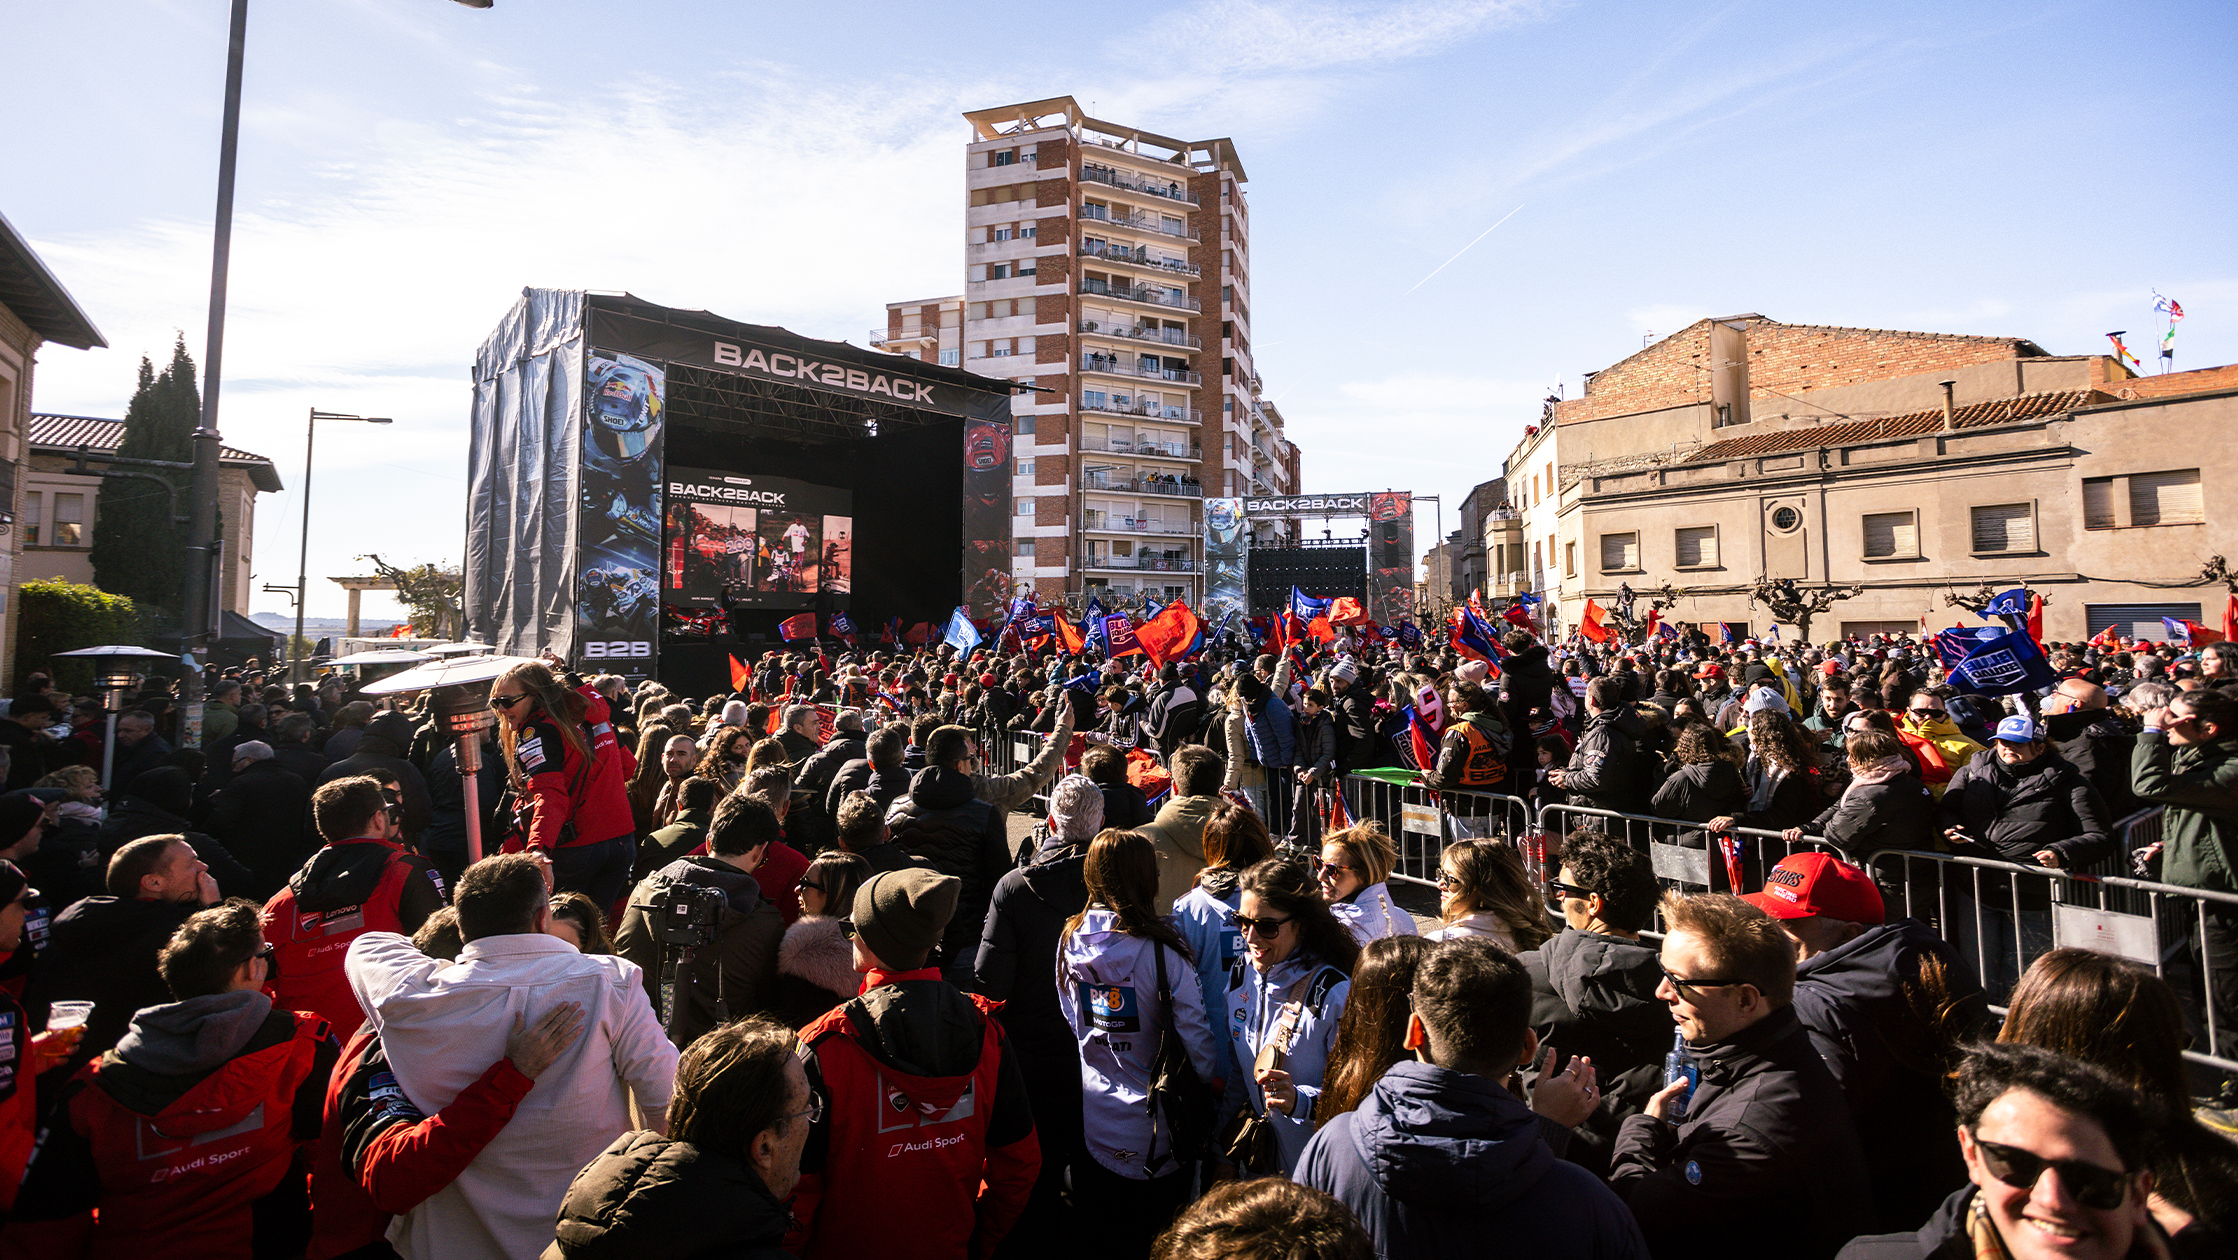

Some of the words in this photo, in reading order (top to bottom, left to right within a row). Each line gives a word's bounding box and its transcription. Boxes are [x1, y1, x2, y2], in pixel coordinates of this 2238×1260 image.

[714, 341, 935, 404] BACK2BACK
[603, 388, 618, 397] Red
[617, 391, 632, 402] Bull
[603, 415, 624, 426] SHOEI
[670, 482, 786, 504] BACK2BACK
[1247, 498, 1364, 511] BACK2BACK
[1109, 619, 1131, 631] BLUE
[585, 641, 652, 657] B2B
[2000, 718, 2026, 731] 73
[325, 904, 358, 919] Lenovo
[334, 941, 351, 950] Spo
[1090, 988, 1120, 1008] BK8
[1094, 1037, 1132, 1052] DUATI
[904, 1140, 933, 1152] Audi
[935, 1133, 964, 1148] Sport
[170, 1157, 205, 1176] Audi
[209, 1146, 251, 1164] Sport
